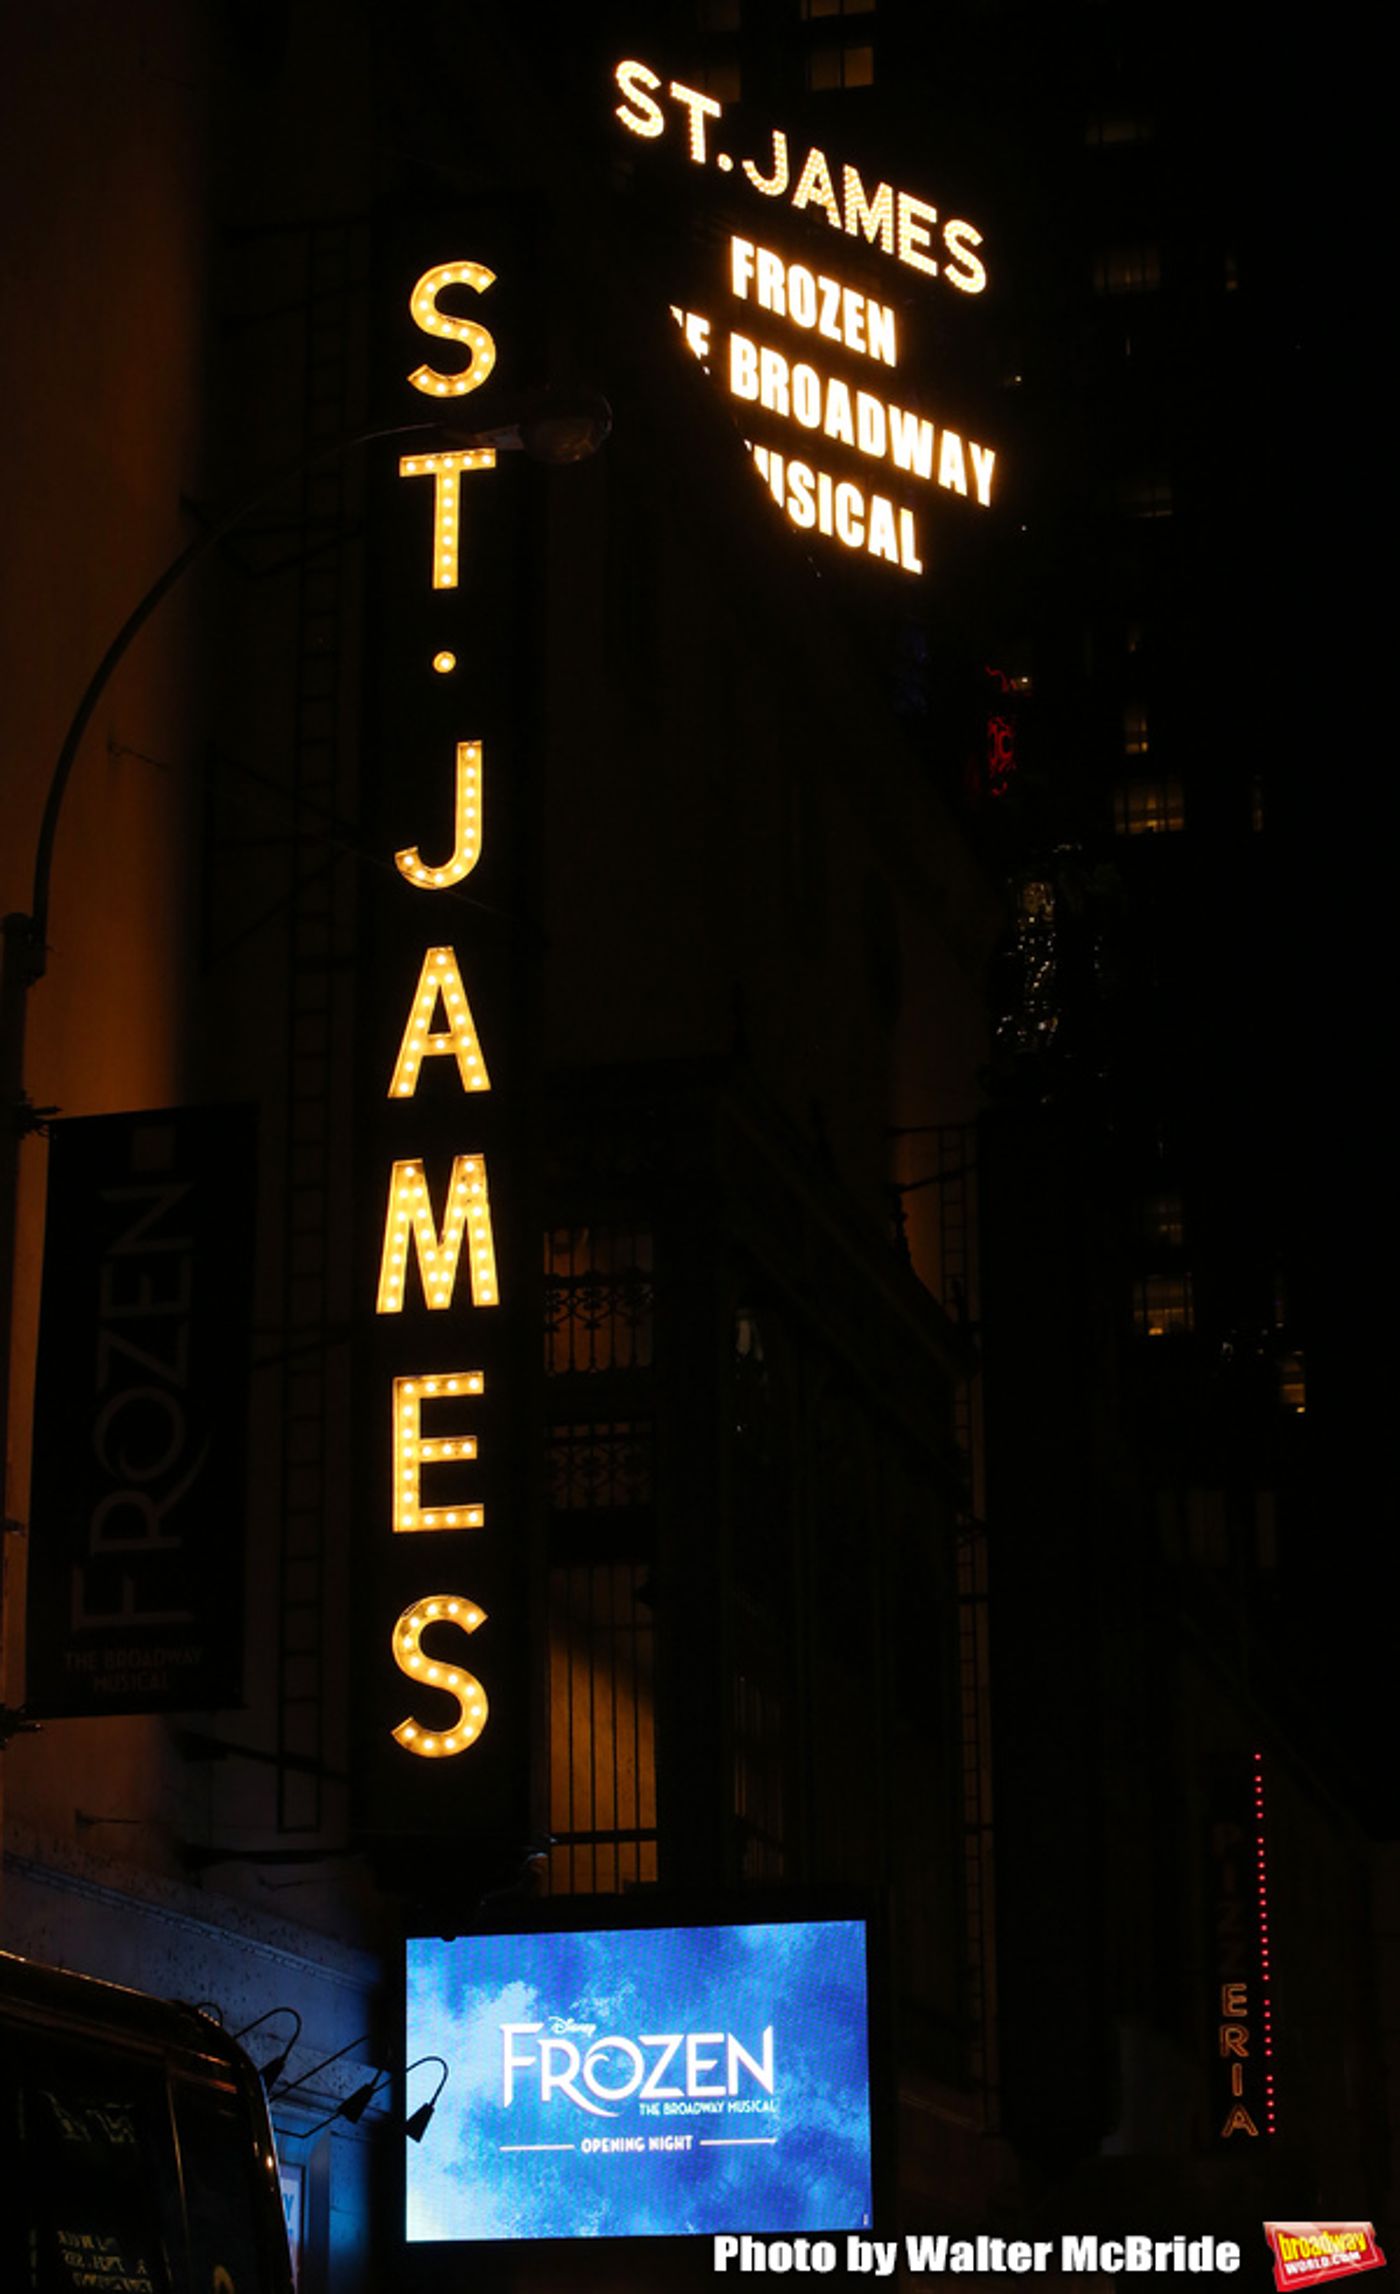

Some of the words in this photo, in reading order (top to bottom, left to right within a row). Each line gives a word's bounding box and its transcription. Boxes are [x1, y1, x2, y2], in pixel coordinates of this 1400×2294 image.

[615, 60, 733, 171] ST.
[742, 130, 987, 294] JAMES
[731, 235, 897, 367] FROZEN
[730, 331, 996, 508] BROADWAY
[744, 439, 923, 575] USICAL
[376, 741, 499, 1757] JAMES
[69, 1181, 212, 1632] FROZEN
[499, 2023, 774, 2117] FROZEN
[549, 2016, 597, 2036] Disney
[581, 2137, 645, 2153] OPENING
[649, 2135, 693, 2151] NIGHT
[639, 2103, 659, 2116] THE
[663, 2101, 723, 2116] BROADWAY
[727, 2100, 776, 2113] MUSICAL
